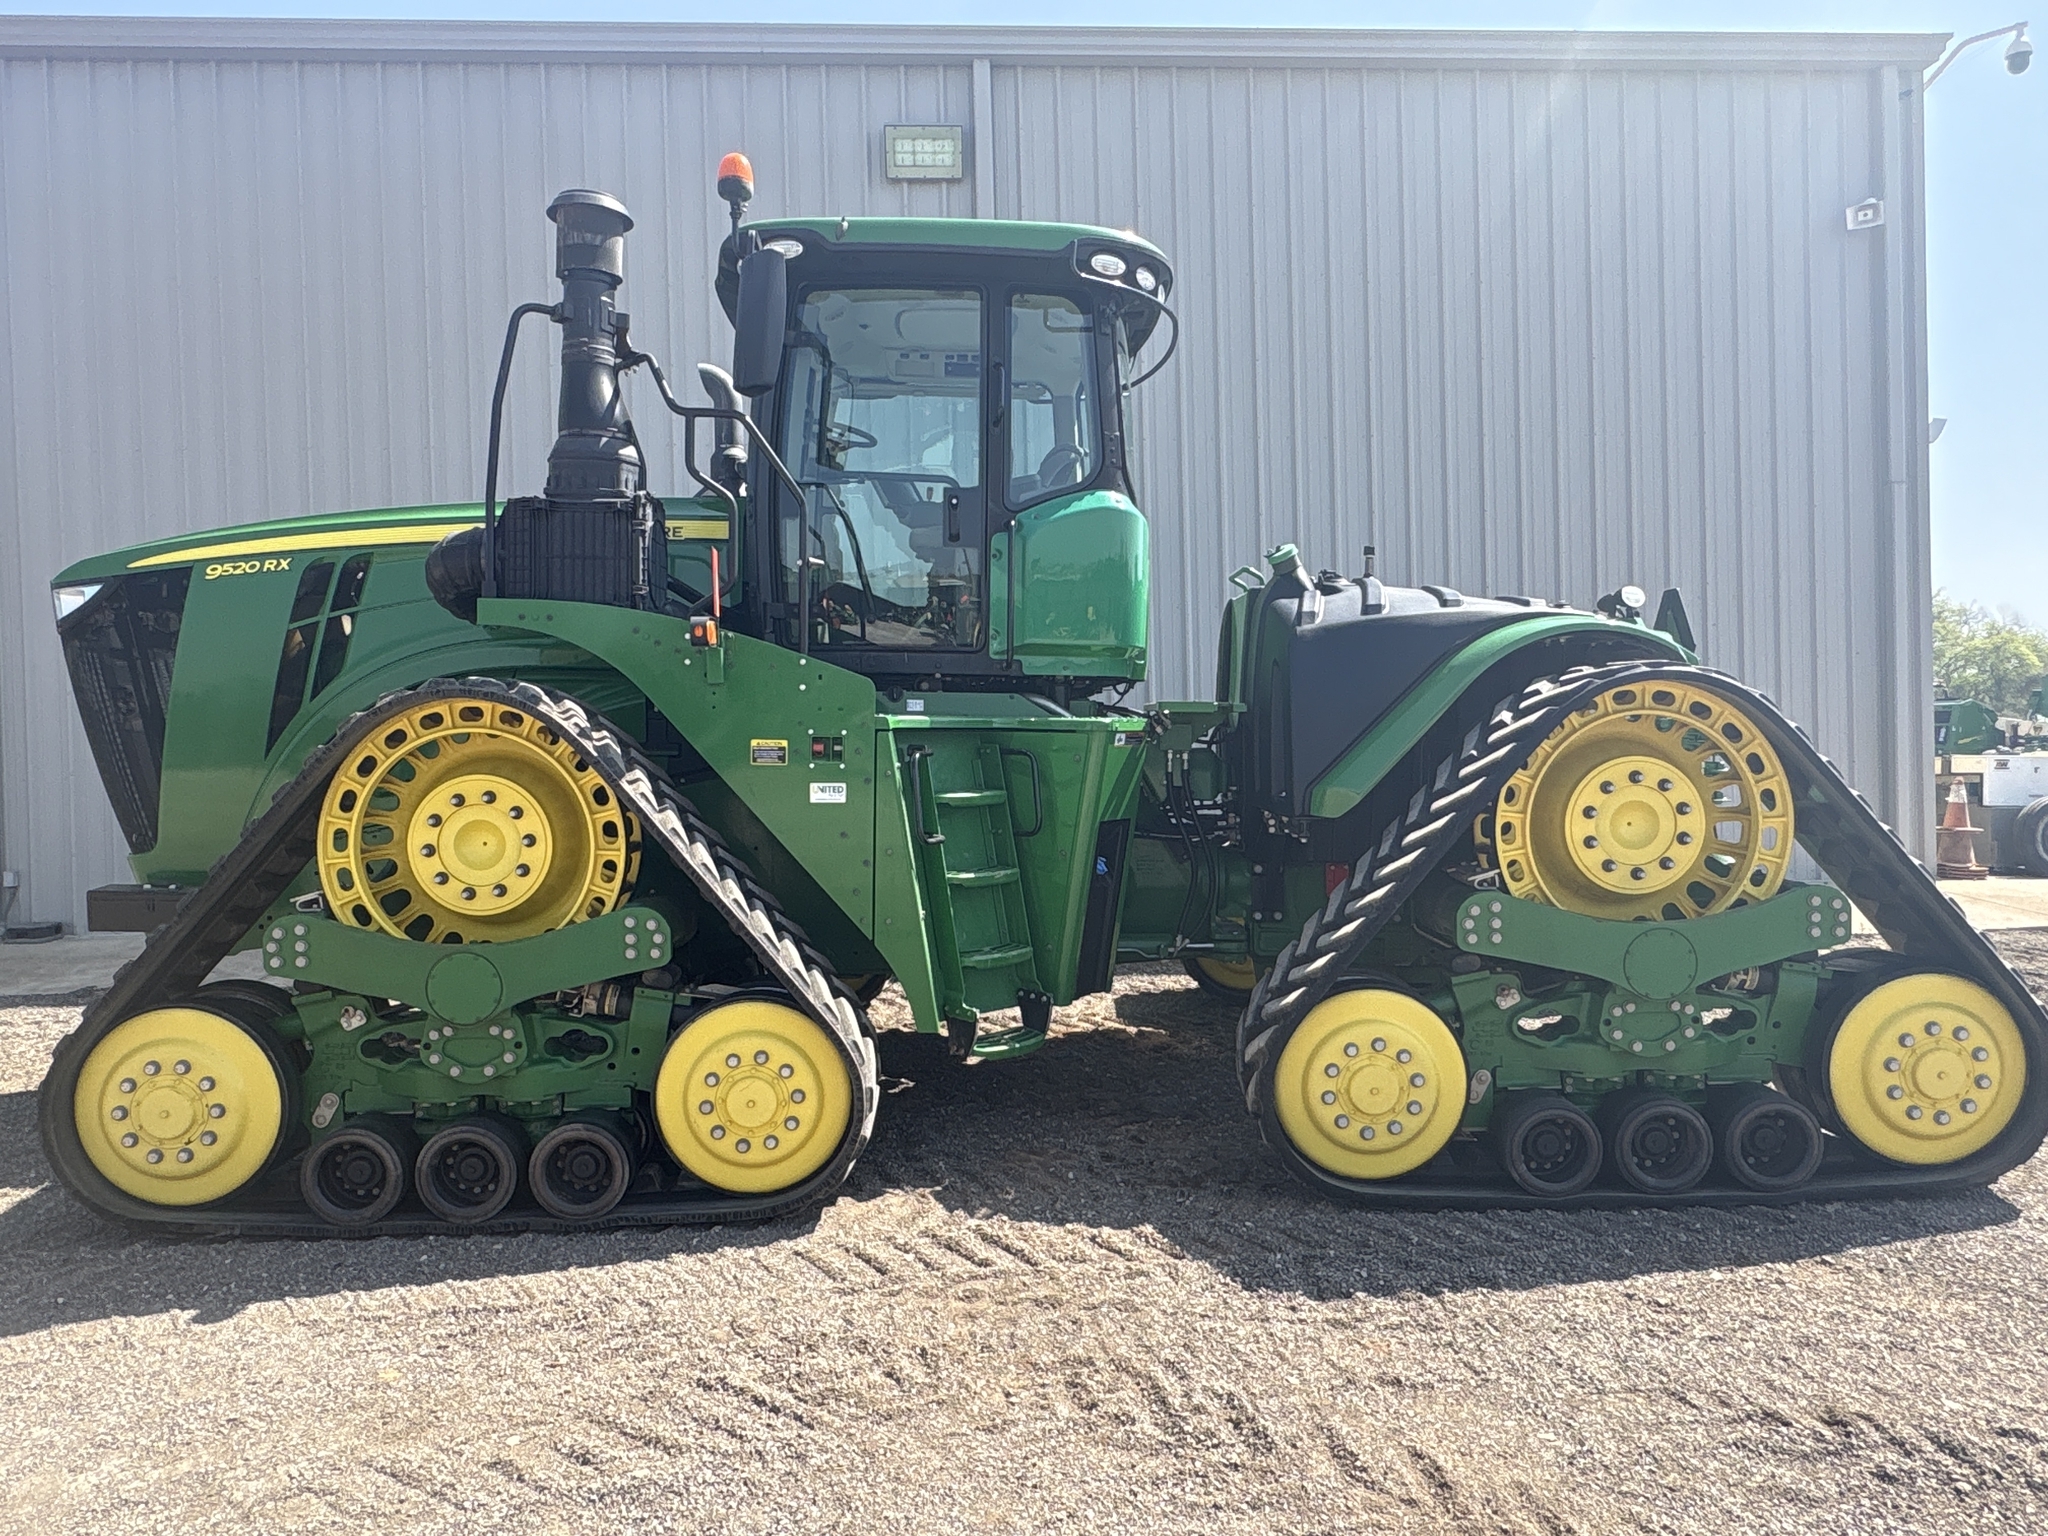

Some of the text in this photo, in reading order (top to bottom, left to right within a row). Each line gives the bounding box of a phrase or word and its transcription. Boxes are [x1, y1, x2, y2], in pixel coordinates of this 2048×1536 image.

[205, 558, 292, 580] 9520 RX
[812, 785, 844, 794] UNITED
